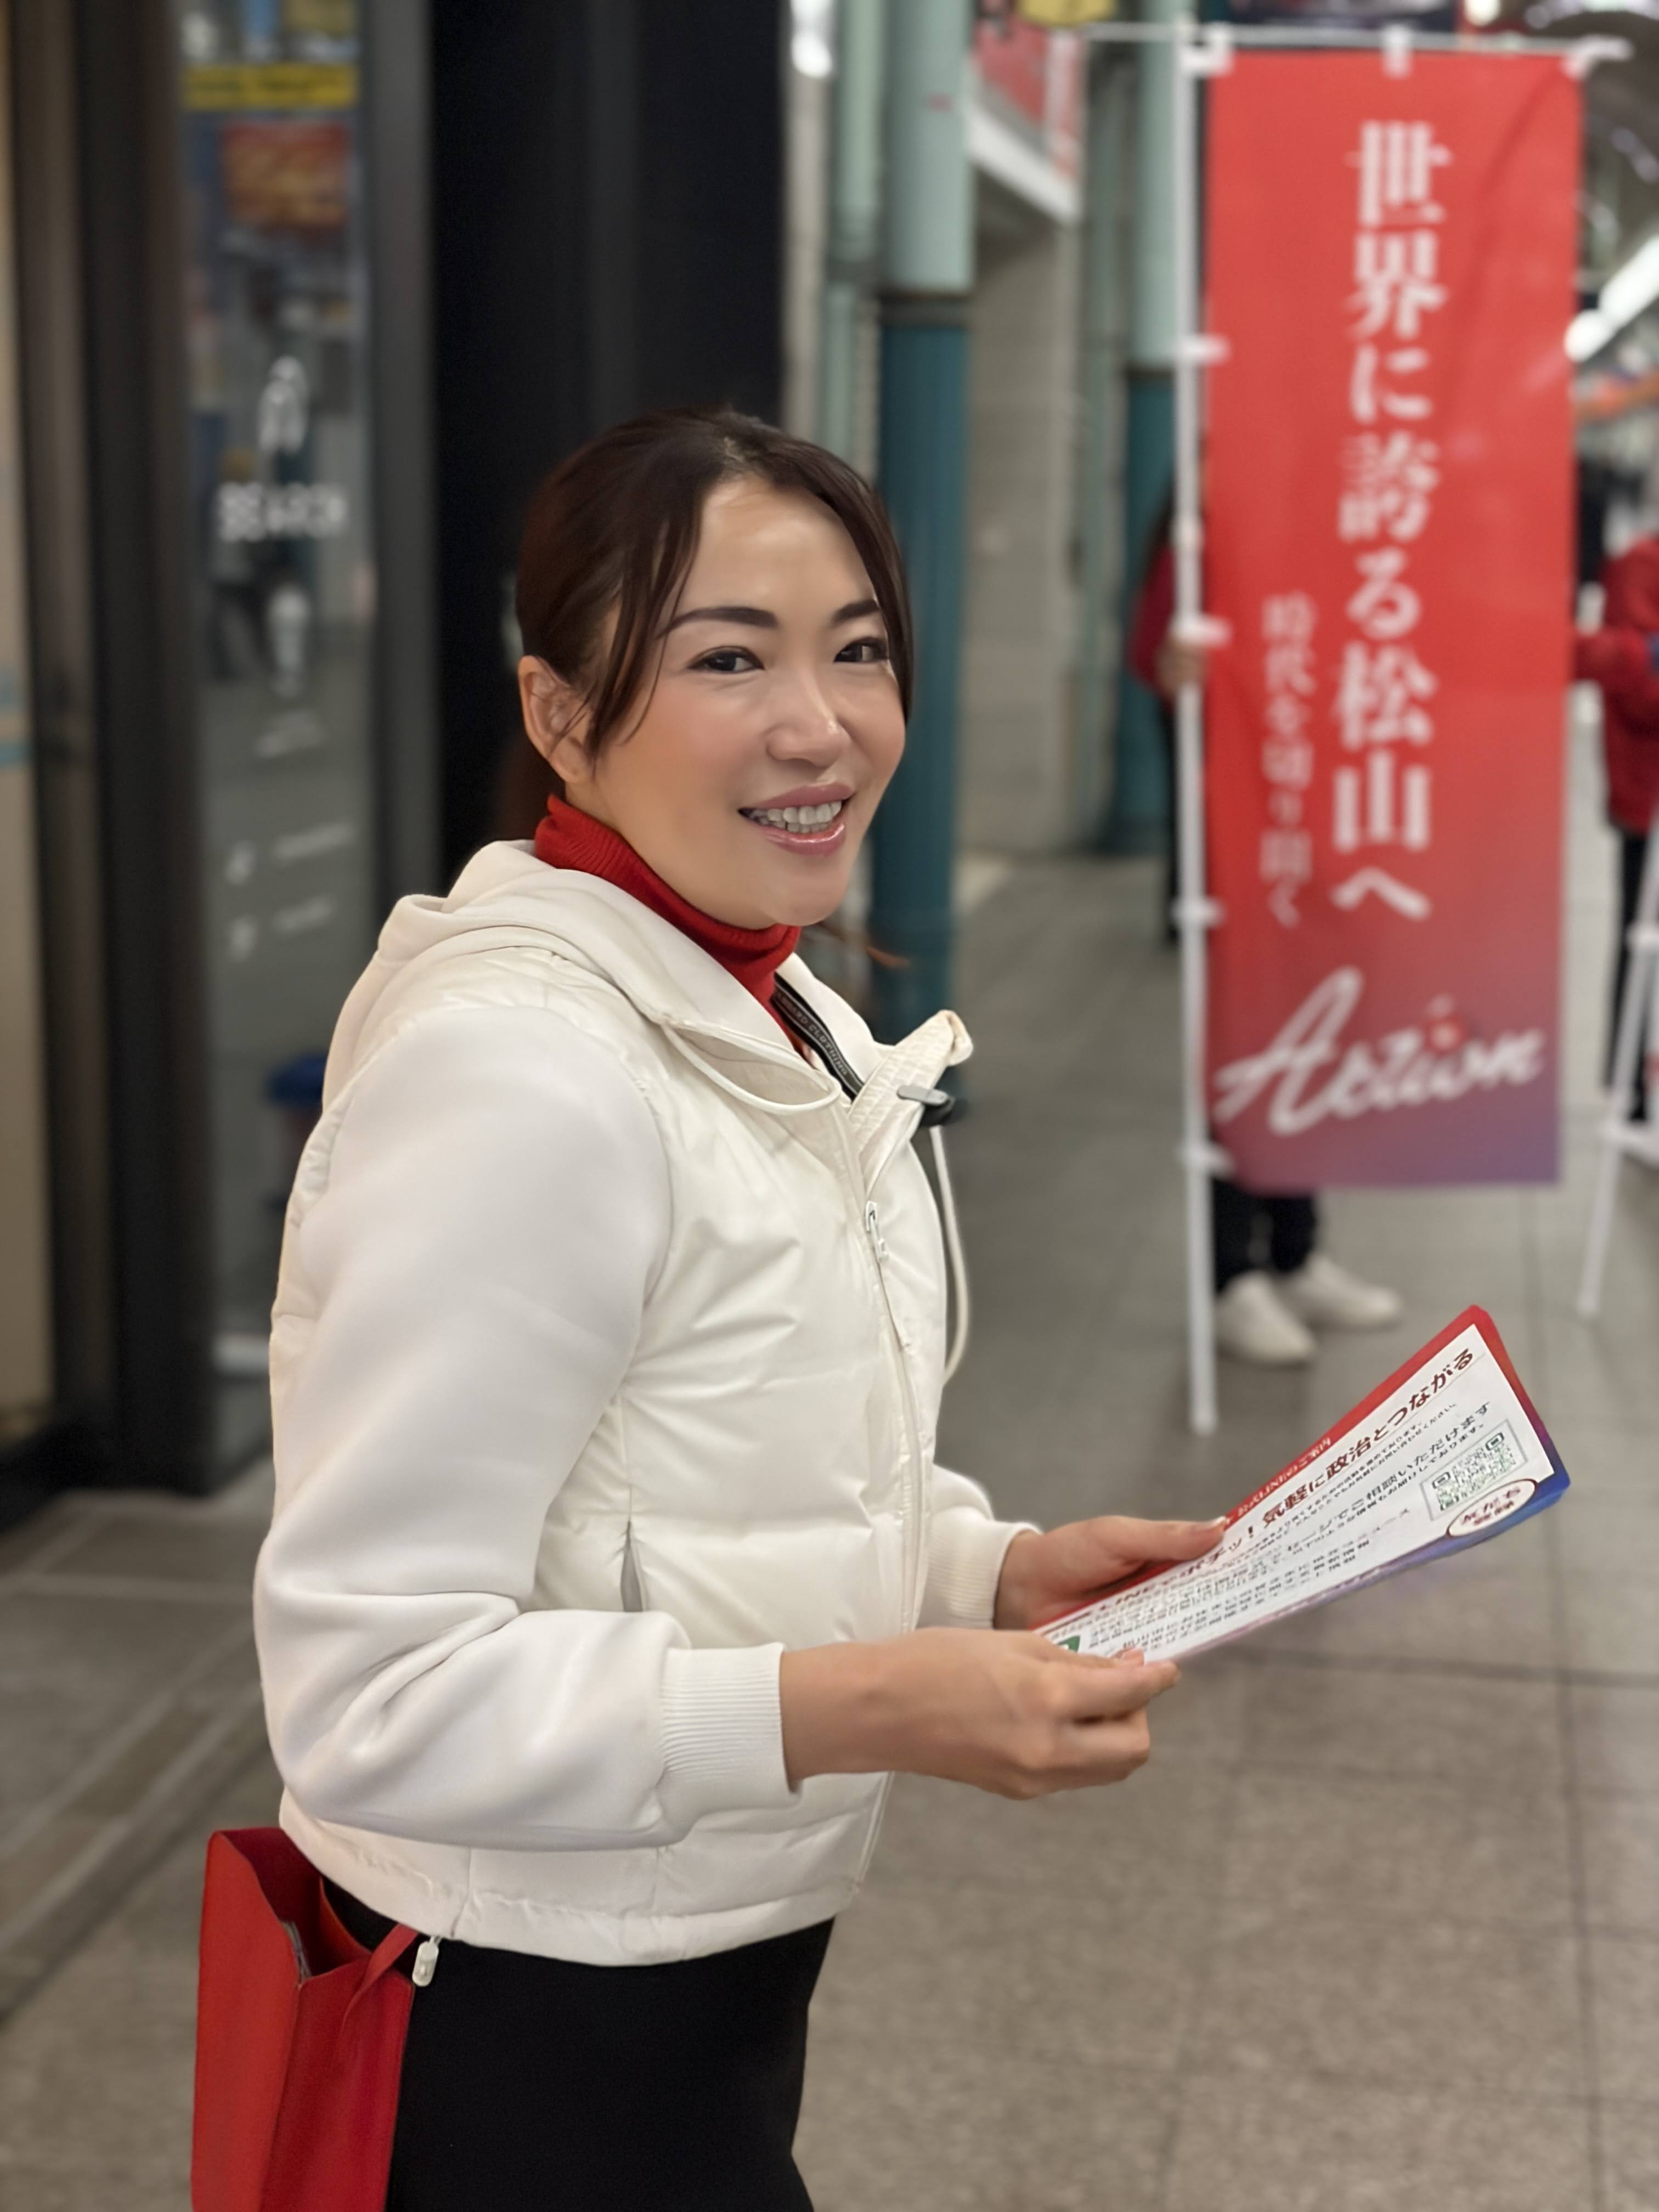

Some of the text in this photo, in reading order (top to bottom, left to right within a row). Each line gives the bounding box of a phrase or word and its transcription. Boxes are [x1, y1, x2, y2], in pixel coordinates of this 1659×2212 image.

[1332, 120, 1452, 921] 世界に誇る松山へ
[809, 1025, 848, 1075] CLOTHING
[1211, 964, 1545, 1137] Action
